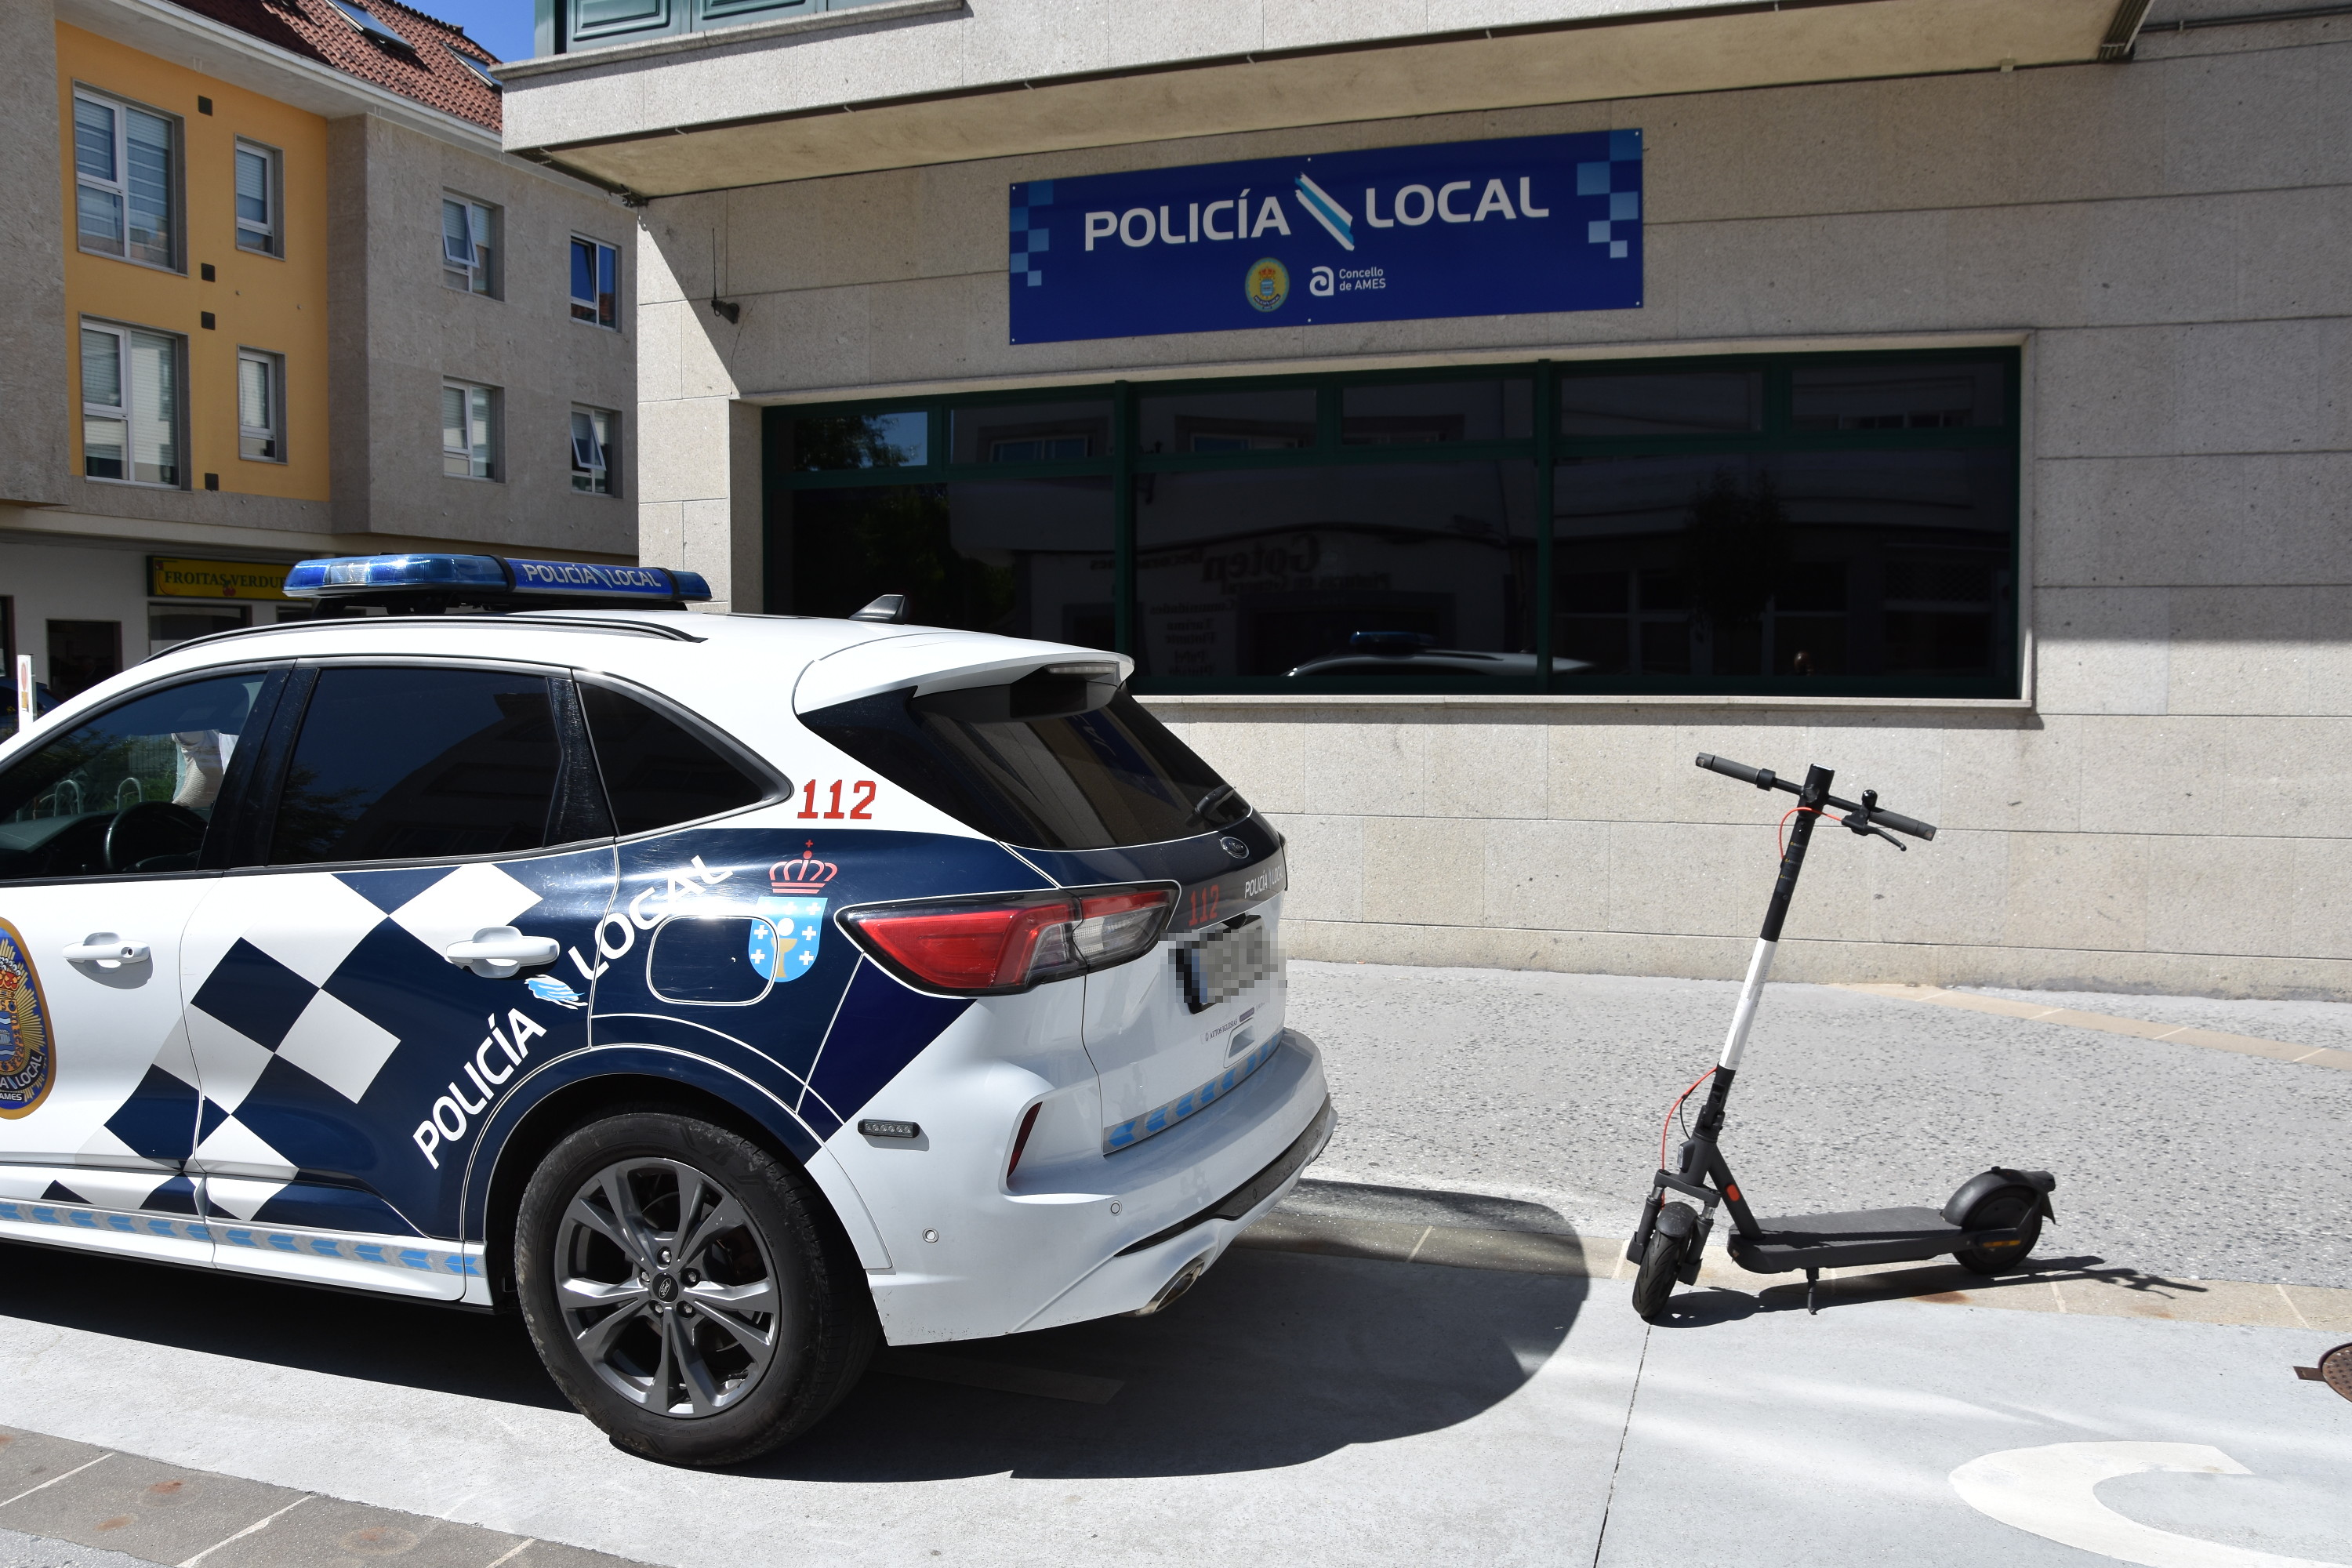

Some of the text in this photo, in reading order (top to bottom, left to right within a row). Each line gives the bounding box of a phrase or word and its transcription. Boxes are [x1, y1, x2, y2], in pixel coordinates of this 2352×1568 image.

[1084, 176, 1550, 252] POLICÍA LOCAL
[1339, 267, 1384, 279] Concello
[1339, 278, 1386, 292] de AMES
[164, 571, 227, 586] FROITAS
[521, 564, 662, 587] POLICÍA LOCAL
[797, 779, 877, 819] 112
[1243, 869, 1268, 899] POLICÍA
[1189, 884, 1220, 927] 112
[412, 855, 734, 1170] POLICÍA LOCAL
[1210, 1027, 1222, 1040] AUTOS
[15, 1055, 42, 1087] LOCAL
